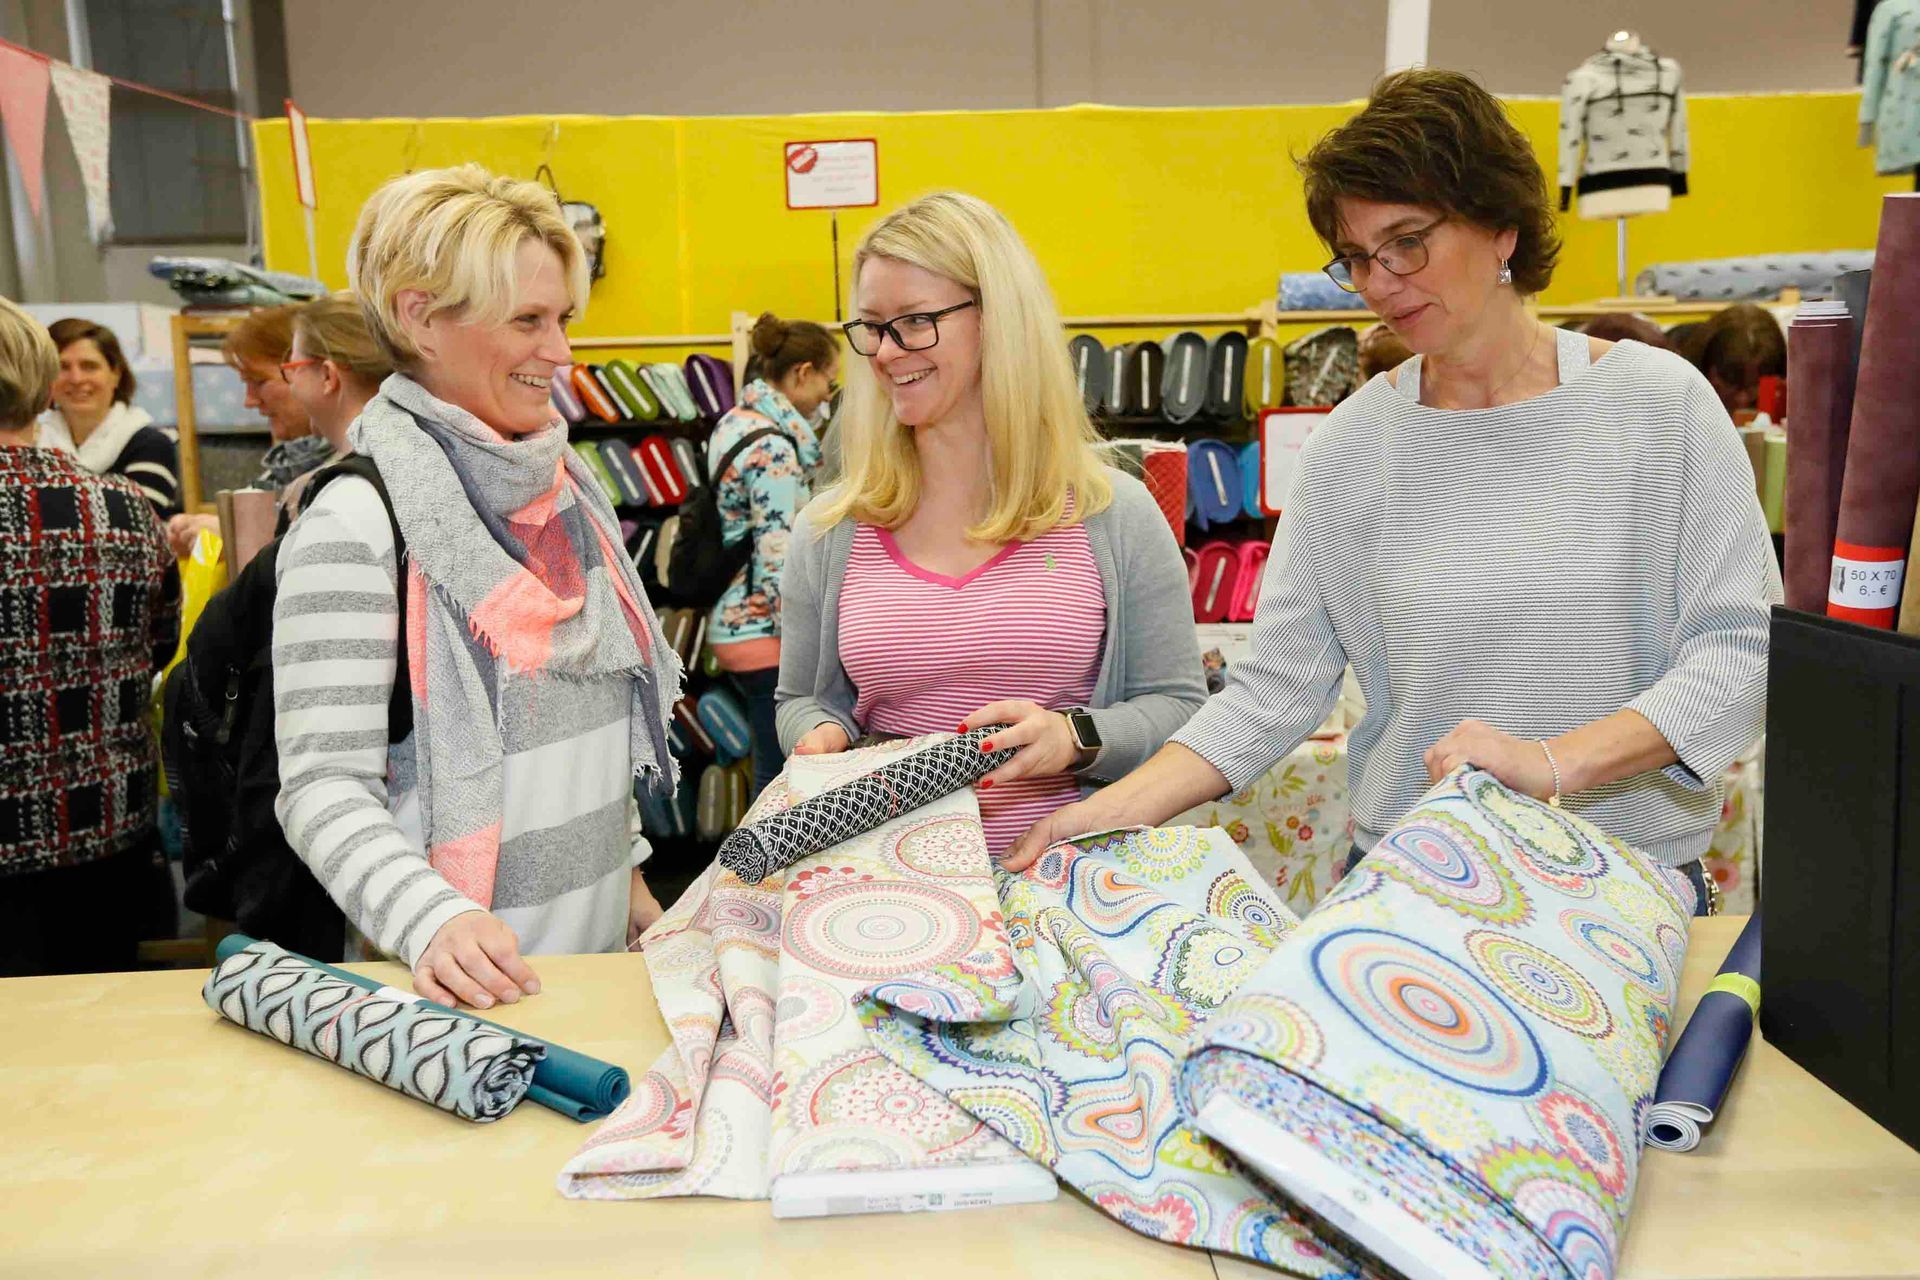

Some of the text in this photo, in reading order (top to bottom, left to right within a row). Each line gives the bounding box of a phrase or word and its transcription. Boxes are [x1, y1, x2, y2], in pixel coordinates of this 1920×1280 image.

[1850, 570, 1867, 581] 50
[1884, 570, 1897, 580] 70
[1880, 584, 1888, 595] €
